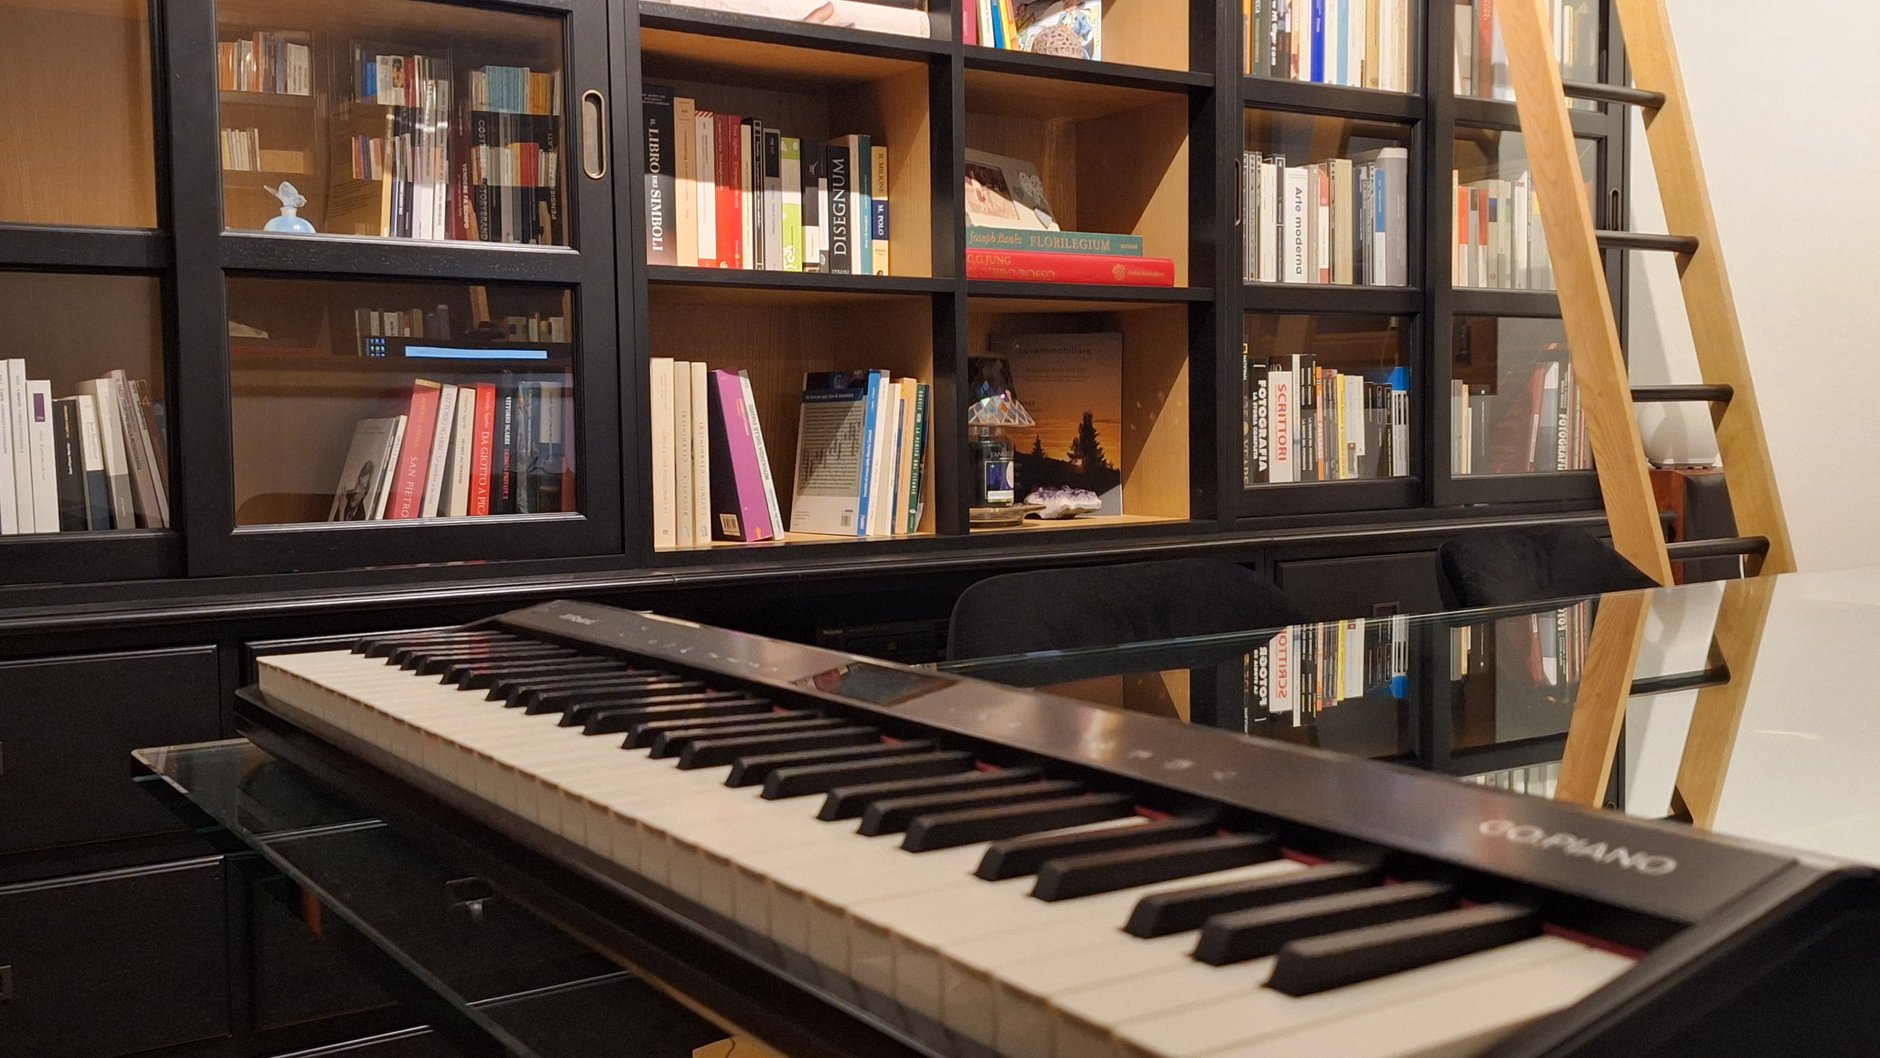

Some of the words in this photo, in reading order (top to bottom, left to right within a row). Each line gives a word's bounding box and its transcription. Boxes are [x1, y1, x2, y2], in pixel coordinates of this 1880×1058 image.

[649, 118, 656, 126] IL
[648, 128, 660, 173] LIBRO
[832, 158, 847, 255] DISEGNUM
[878, 204, 884, 214] M.
[1295, 187, 1303, 212] Arte
[650, 190, 663, 251] SIMBOLI
[969, 230, 996, 245] Joseph
[999, 233, 1023, 245] Banks
[1030, 235, 1110, 251] FLORILEGIUM
[1295, 217, 1303, 275] moderna
[985, 256, 1011, 265] JUNG
[441, 392, 453, 425] VITTORIO
[1252, 391, 1258, 400] LA
[1258, 379, 1267, 472] FOTOGRAFIA
[1278, 384, 1287, 461] SCRITTORI
[481, 431, 490, 445] DA
[407, 456, 418, 477] SAN
[479, 446, 489, 486] GIOTTO
[401, 481, 415, 518] PIETRO
[478, 488, 487, 496] A
